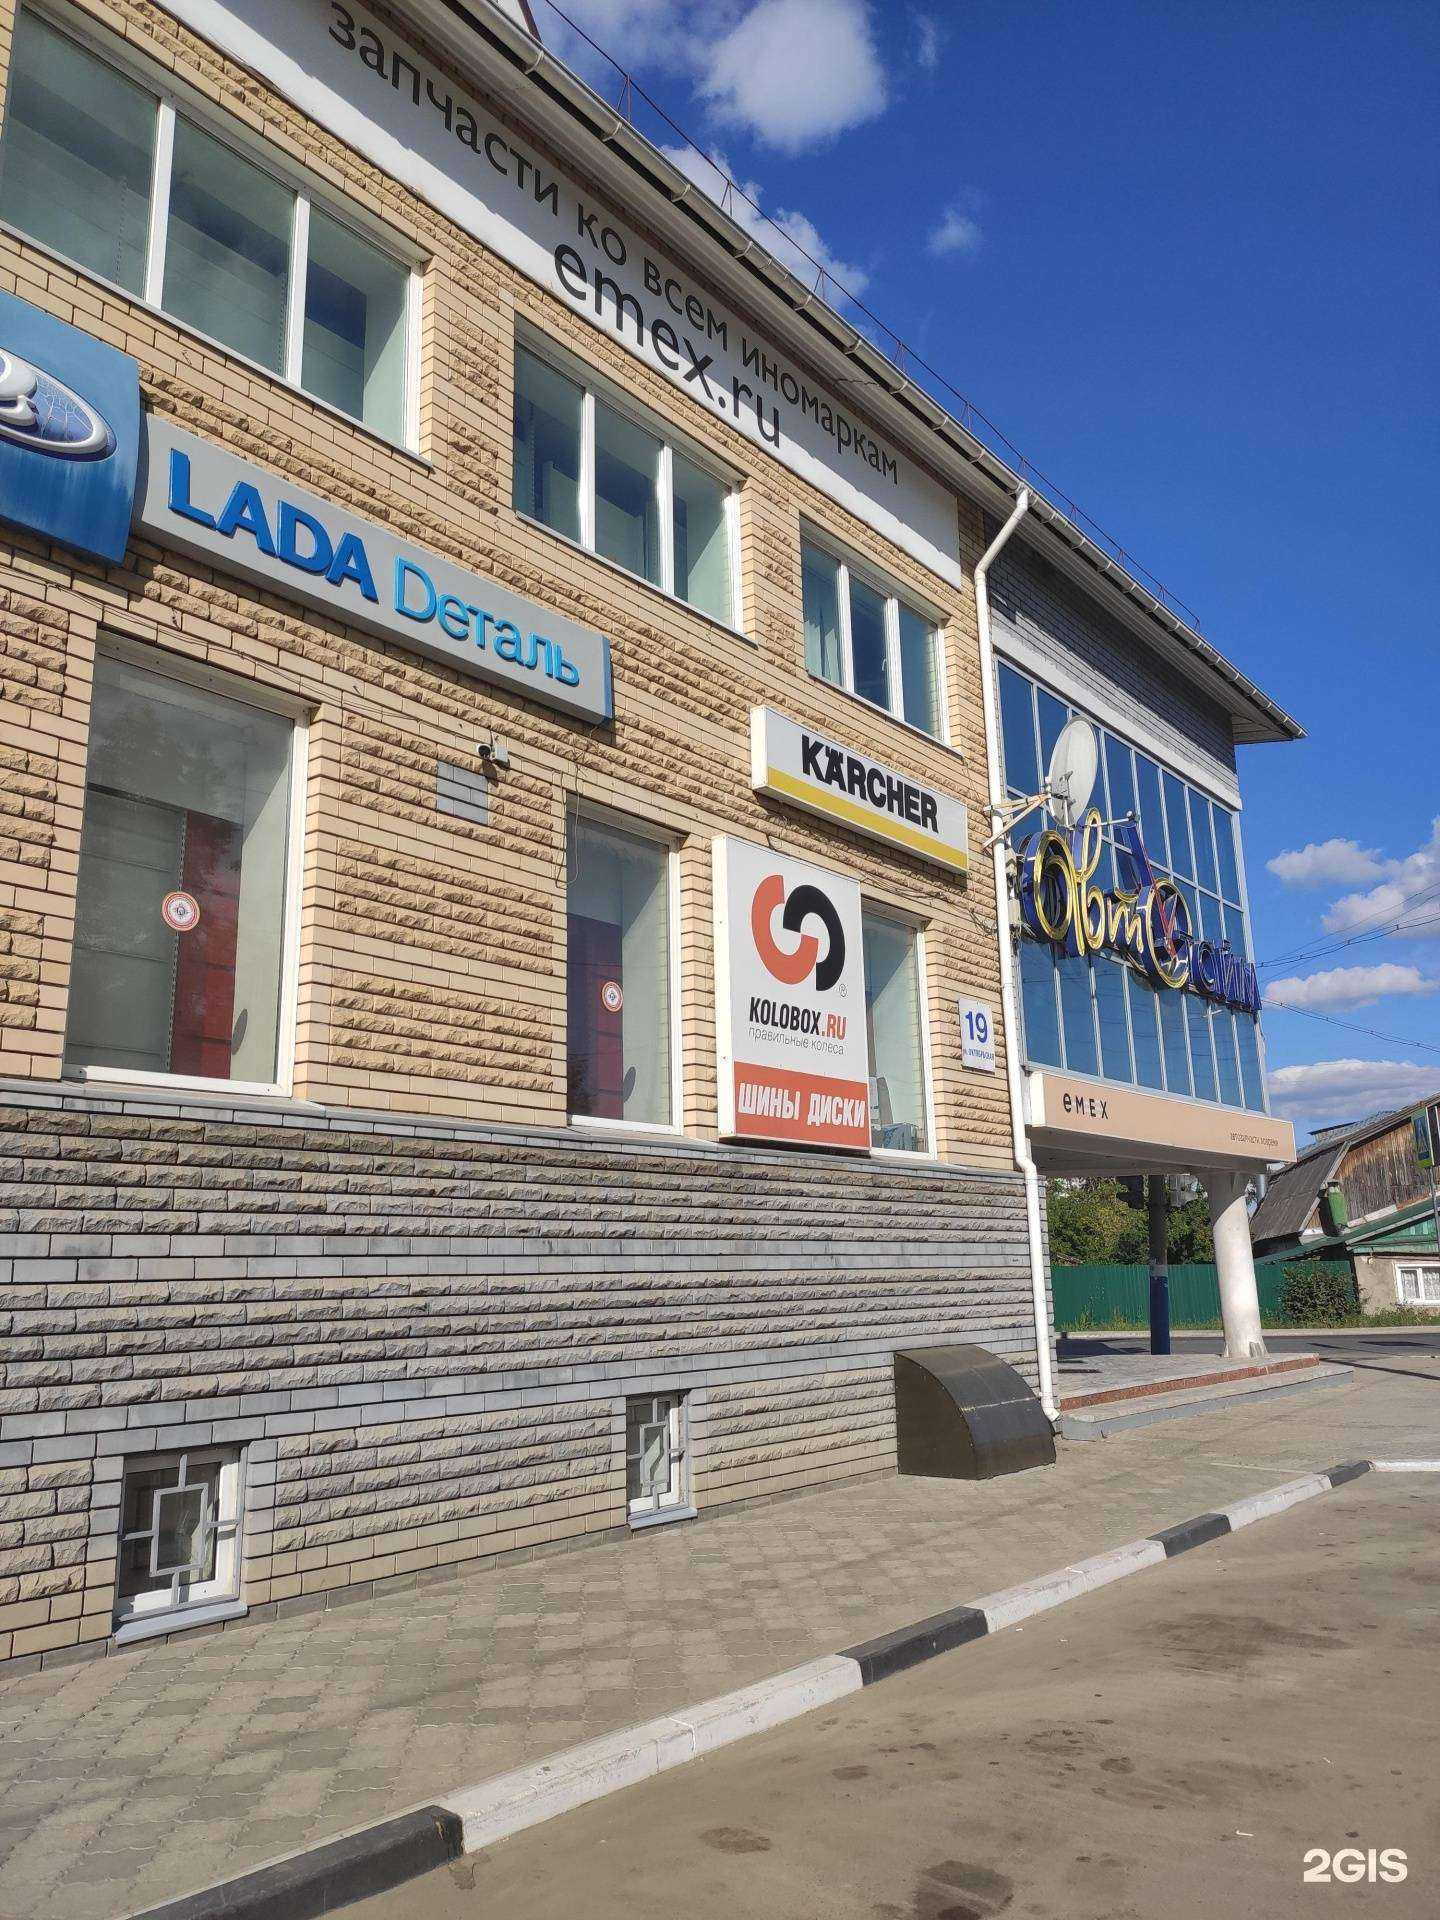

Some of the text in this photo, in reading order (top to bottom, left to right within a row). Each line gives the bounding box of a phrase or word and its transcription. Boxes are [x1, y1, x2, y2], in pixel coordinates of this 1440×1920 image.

[328, 4, 899, 487] запчасти ко всем иномаркам
[554, 243, 781, 450] emex.ru
[168, 447, 379, 604] LADA
[801, 733, 940, 833] KÄRCHER
[748, 1026, 845, 1056] правильные колеса
[749, 996, 848, 1041] KOLOBOX.RU
[965, 1011, 988, 1044] 19
[738, 1082, 867, 1128] ШИНЫ ДИСКИ
